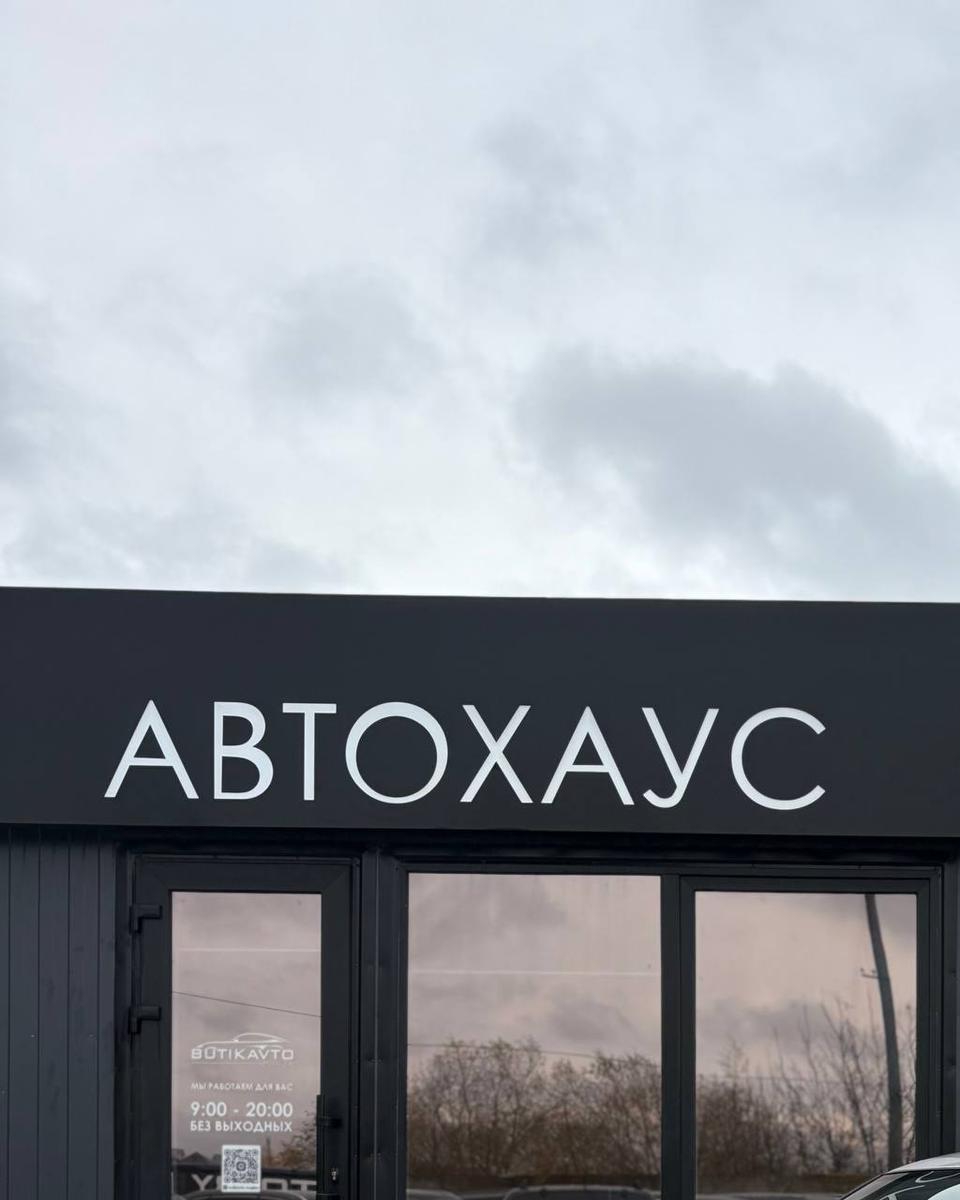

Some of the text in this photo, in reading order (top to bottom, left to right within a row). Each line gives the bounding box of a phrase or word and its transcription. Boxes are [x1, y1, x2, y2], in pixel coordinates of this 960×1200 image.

[104, 699, 827, 811] АВТОХАУС
[191, 1047, 294, 1060] BUTIKAVTO
[190, 1102, 227, 1117] 9:00
[246, 1102, 293, 1117] 20:00
[190, 1121, 292, 1132] БЕЗ ВЫХОДНЫХ
